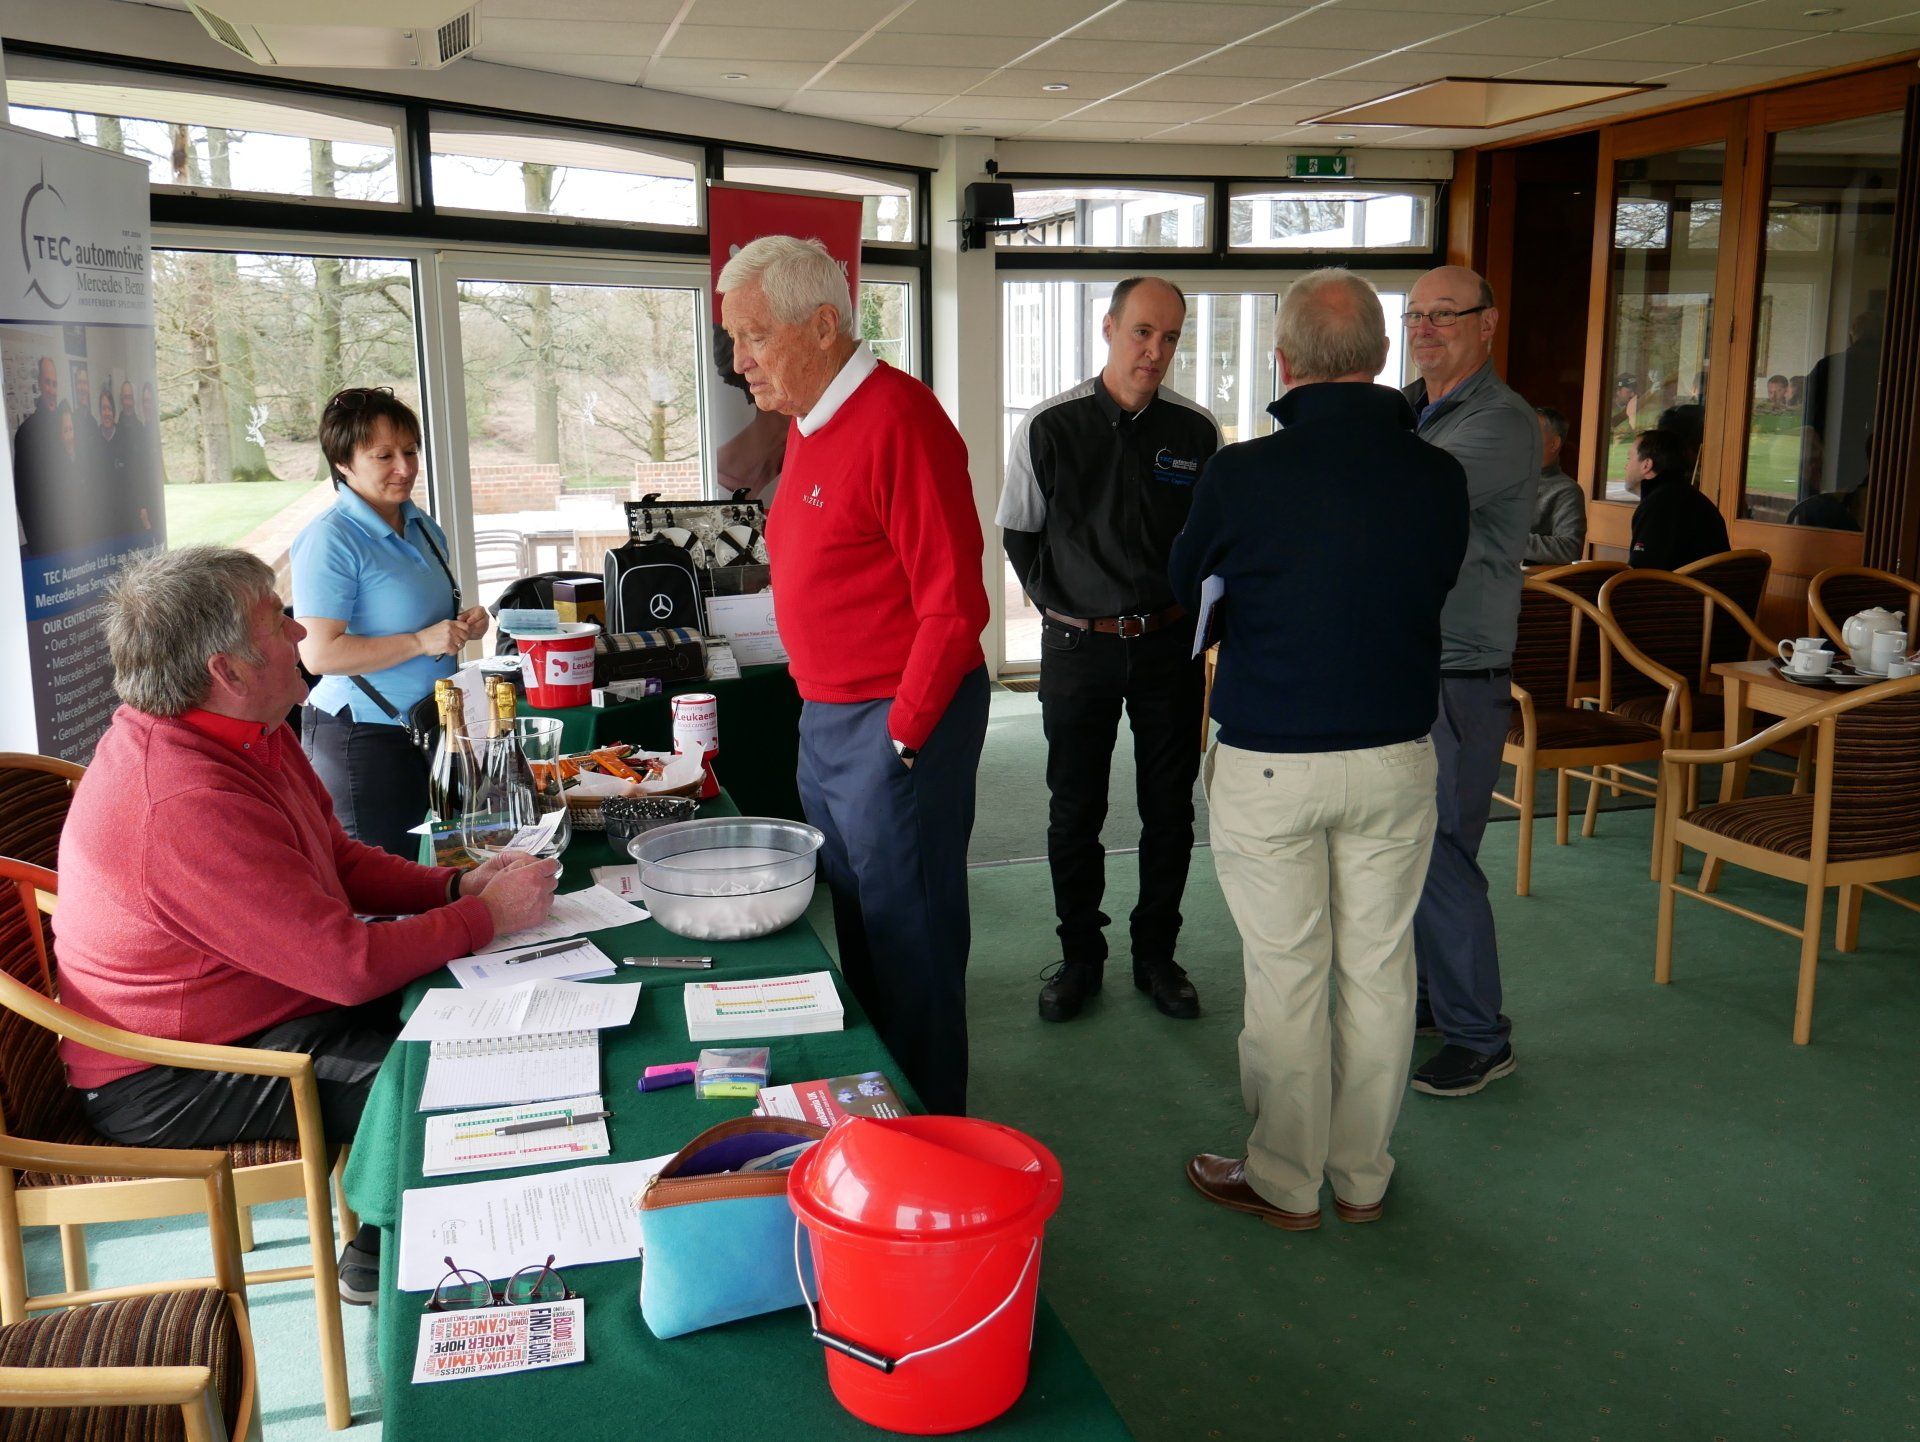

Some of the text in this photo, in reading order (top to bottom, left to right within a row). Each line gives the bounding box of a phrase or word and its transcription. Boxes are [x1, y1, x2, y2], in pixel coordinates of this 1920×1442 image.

[33, 235, 144, 271] TEC automotive
[76, 272, 145, 296] Mercedes Benz
[43, 569, 61, 586] TEC
[61, 559, 96, 582] Automotive
[97, 554, 109, 570] Ltd
[109, 553, 117, 566] is
[35, 579, 90, 609] Mercedes-Benz
[42, 619, 63, 635] OUR
[62, 610, 87, 631] CENTRE
[50, 638, 69, 652] Over
[676, 711, 716, 721] Leukaem
[58, 720, 86, 741] Genuine
[60, 743, 79, 759] every
[806, 1090, 818, 1101] UK
[452, 1318, 507, 1336] CANCER
[508, 1318, 528, 1326] DONOR
[530, 1308, 552, 1332] FIND
[553, 1316, 572, 1340] BLOOD
[434, 1334, 515, 1354] ANGER HOPE
[528, 1342, 551, 1364] CURE
[438, 1349, 522, 1370] LEUKAEMIA
[479, 1360, 524, 1371] ACCEPTANCE
[440, 1366, 476, 1376] SUCCESS
